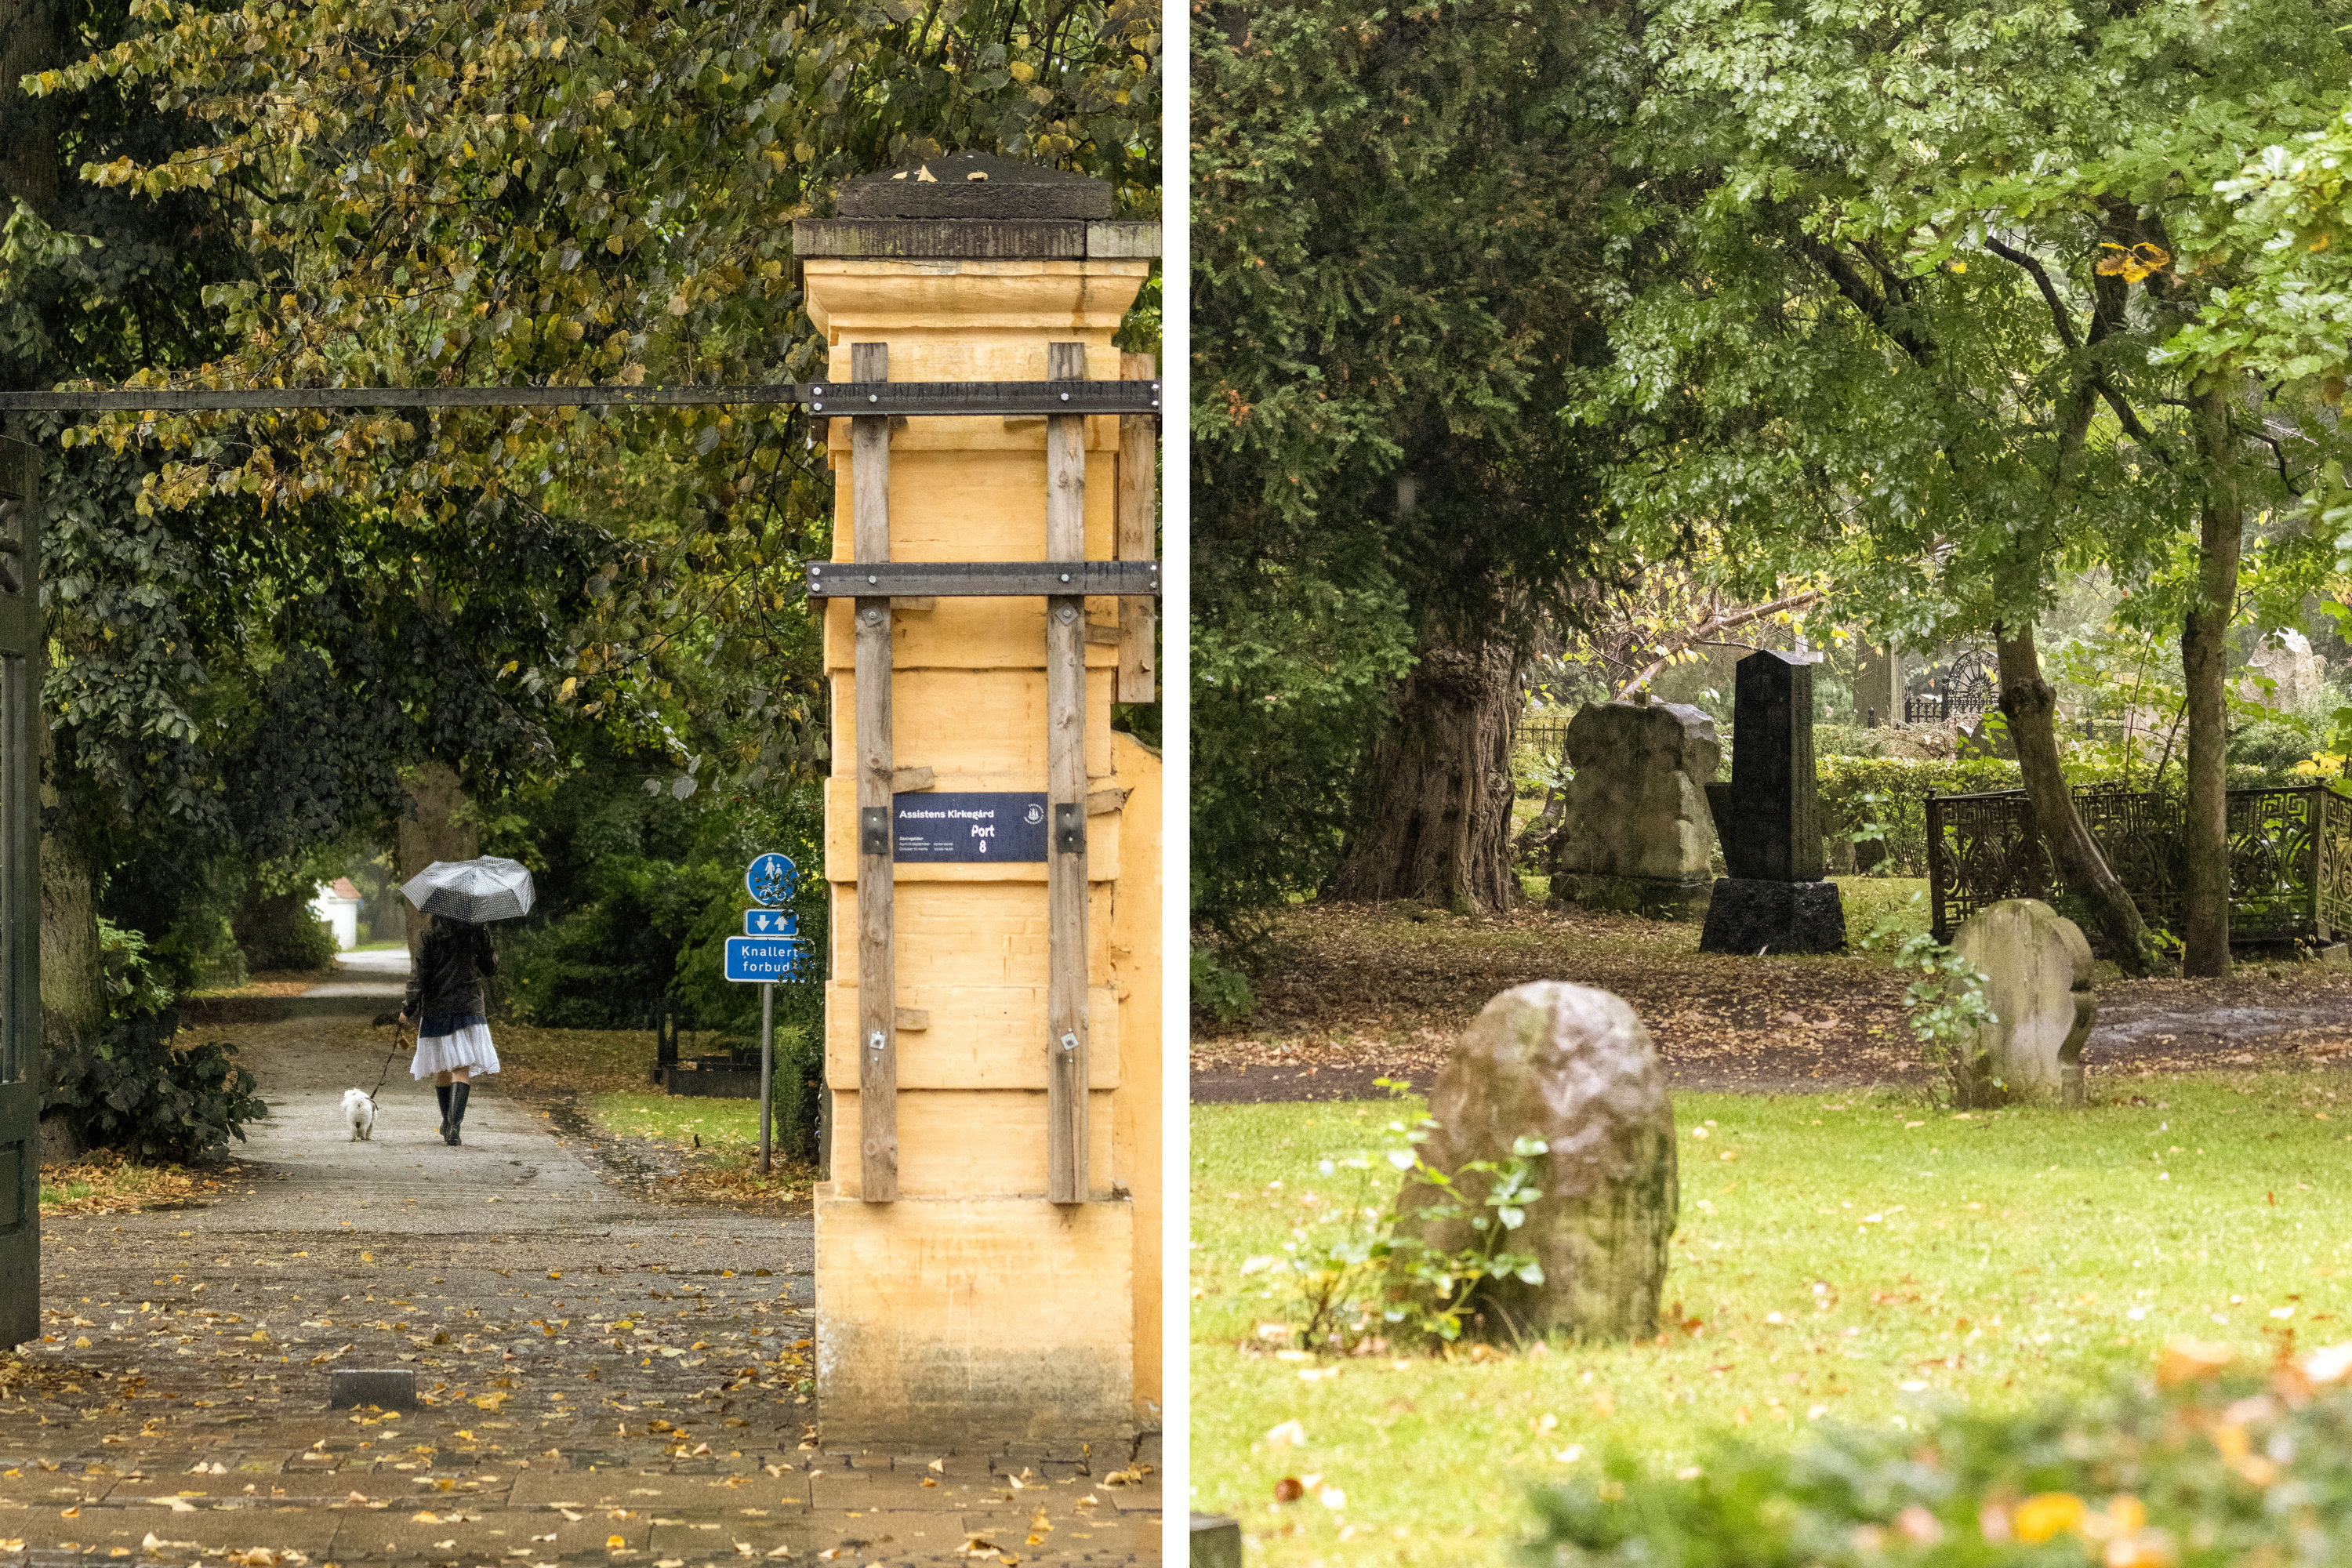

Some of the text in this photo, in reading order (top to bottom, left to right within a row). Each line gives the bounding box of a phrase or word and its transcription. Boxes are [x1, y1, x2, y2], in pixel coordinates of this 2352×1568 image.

[899, 810, 994, 820] Assistens Kirkegård
[971, 824, 995, 837] Port
[978, 840, 986, 853] 8
[742, 946, 798, 956] Knallert
[743, 961, 789, 972] forbud
